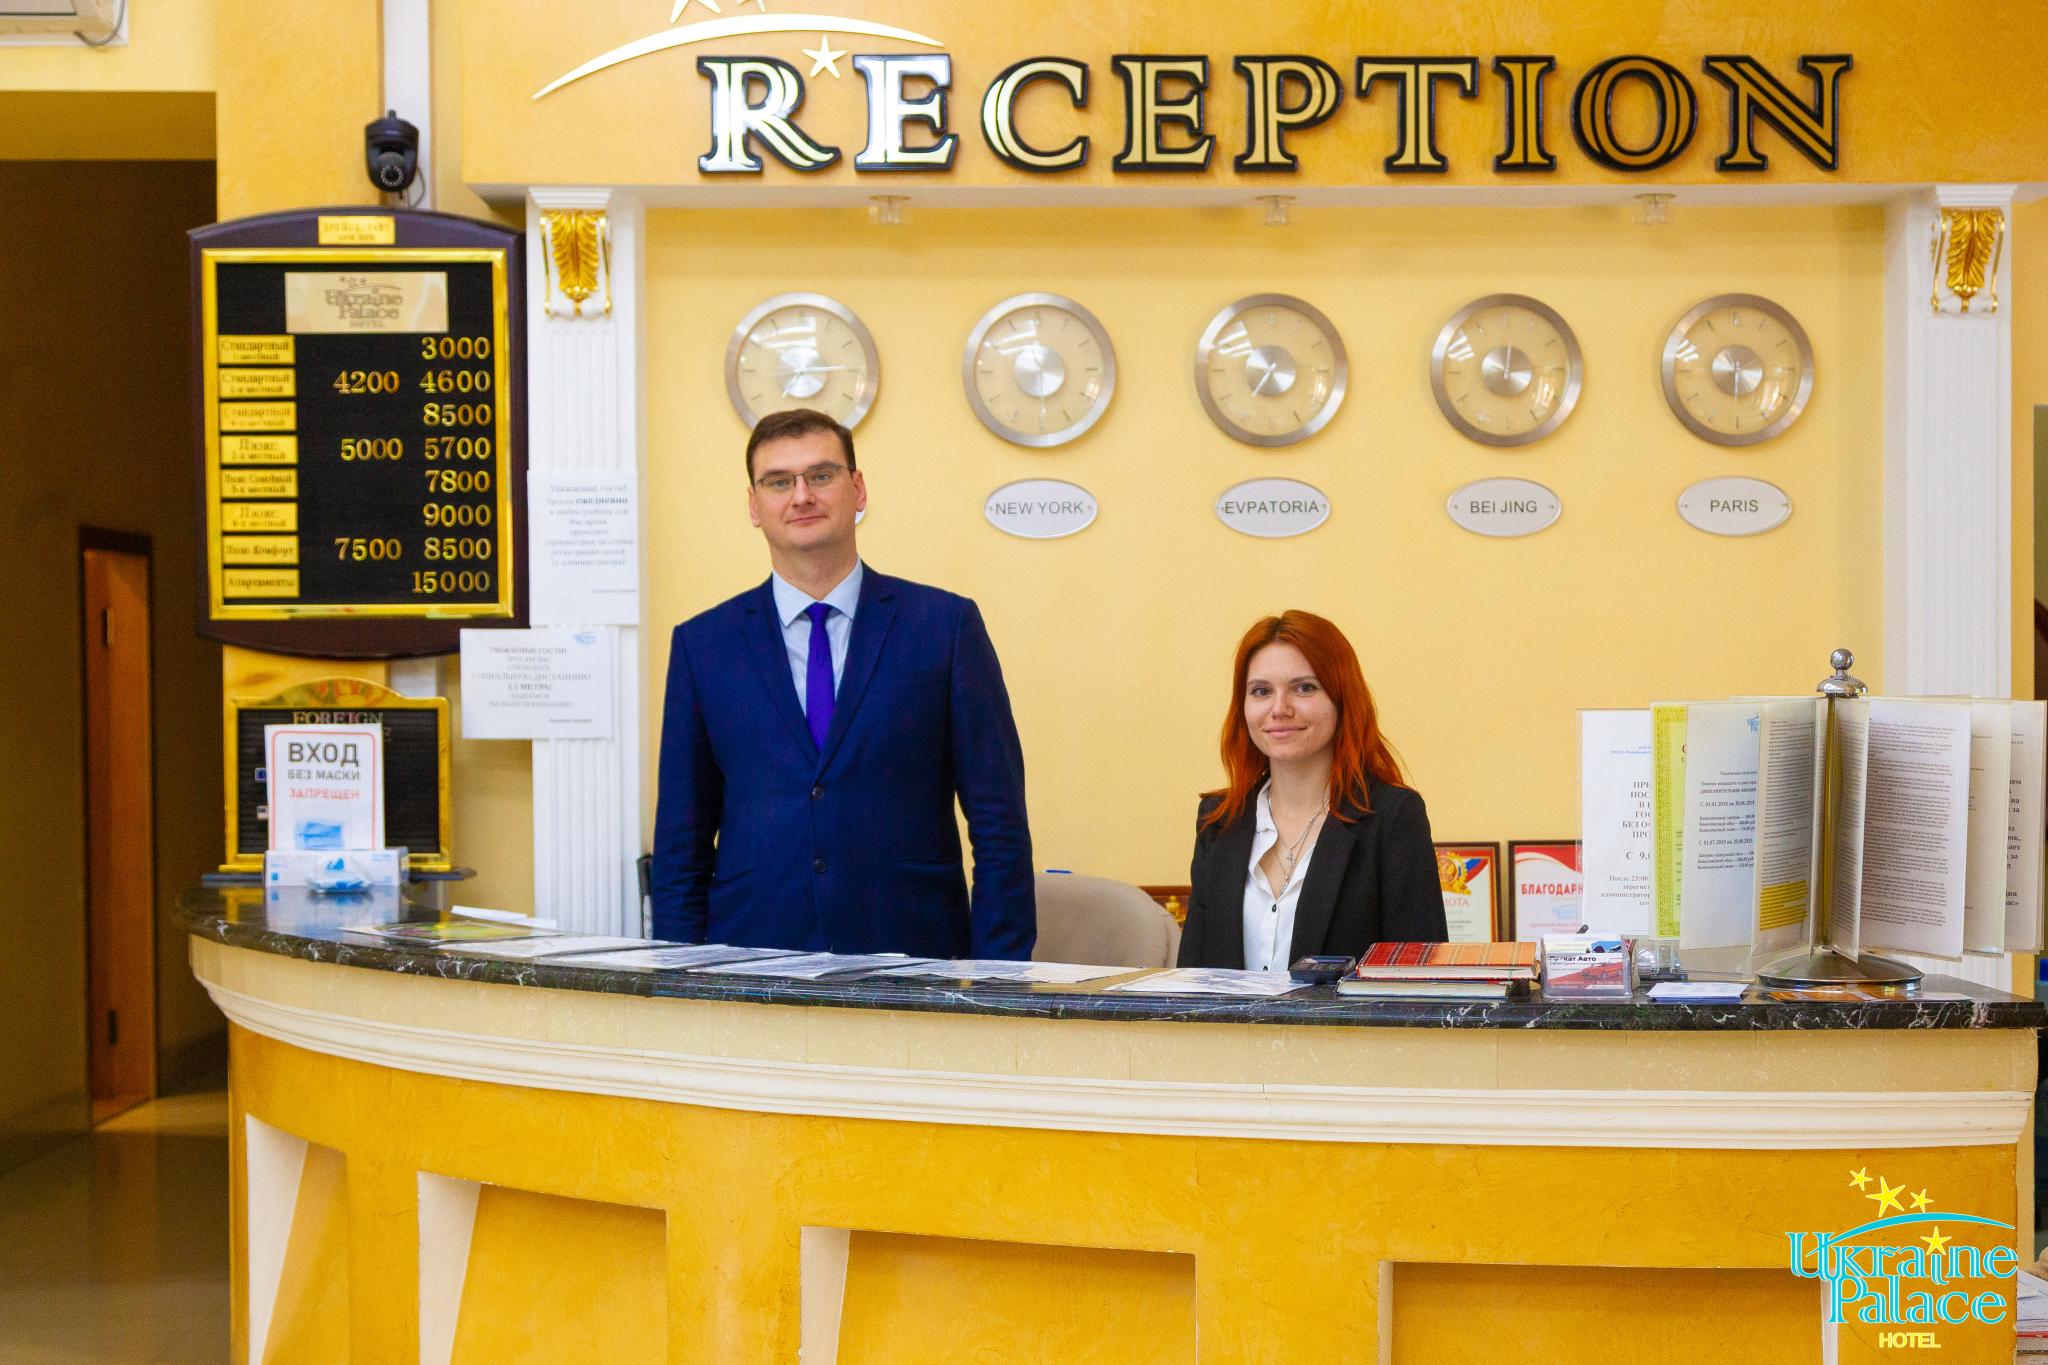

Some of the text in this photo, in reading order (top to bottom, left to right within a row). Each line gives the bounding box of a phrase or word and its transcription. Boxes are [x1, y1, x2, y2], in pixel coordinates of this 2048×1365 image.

[697, 54, 1853, 172] RECEPTION
[325, 289, 403, 307] Ukraine
[338, 303, 399, 319] Palace
[421, 336, 491, 360] 3000
[333, 370, 400, 394] 4200
[418, 370, 491, 394] 4600
[423, 403, 492, 427] 8500
[340, 438, 403, 461] 5000
[424, 436, 491, 460] 5700
[425, 470, 491, 494] 7800
[423, 503, 492, 527] 9000
[995, 501, 1084, 515] NEW YORK
[1225, 500, 1320, 514] EVPATORIA
[1710, 499, 1759, 512] PARIS
[334, 537, 402, 561] 7500
[424, 537, 492, 560] 8500
[411, 571, 491, 594] 15000
[293, 711, 383, 724] FOREIGN
[288, 742, 359, 767] ВХОД
[288, 769, 361, 780] БЕЗ МАСКИ
[289, 788, 361, 800] ЗАПРЕЩЕН
